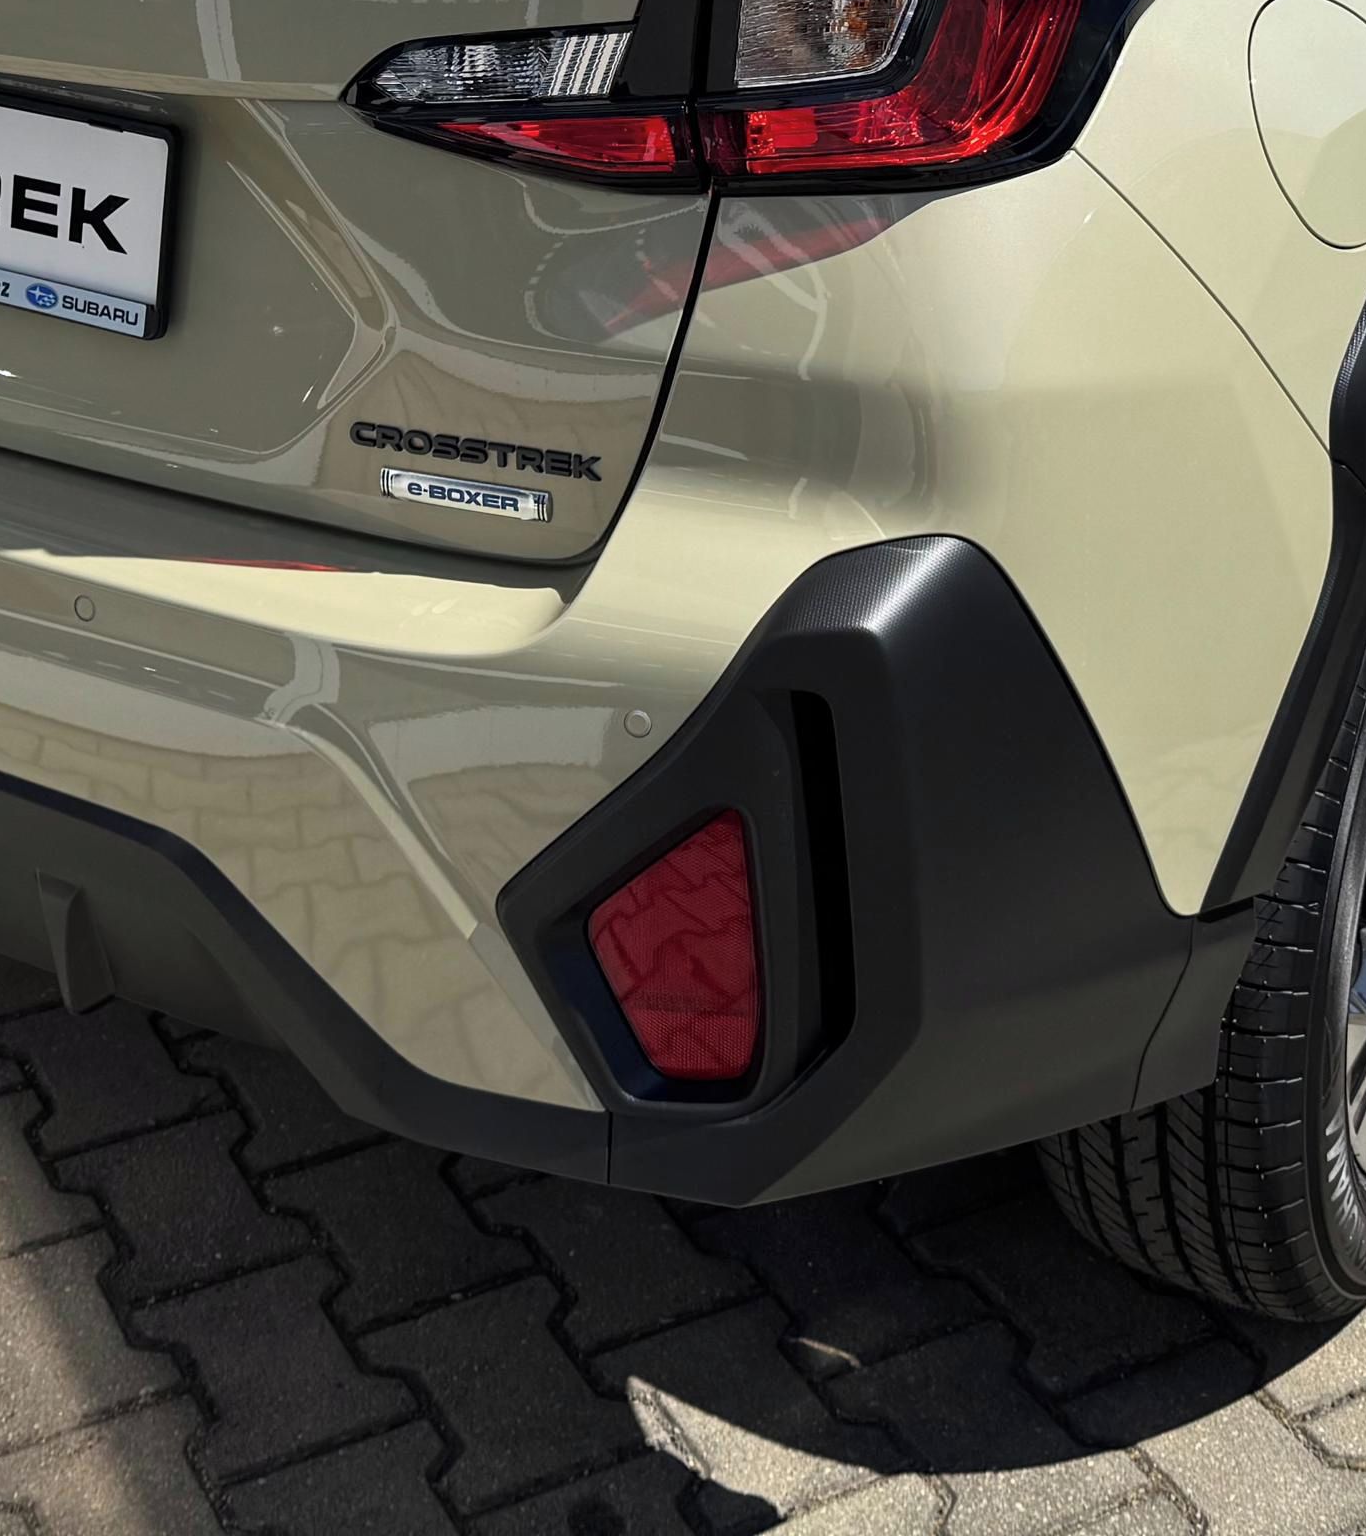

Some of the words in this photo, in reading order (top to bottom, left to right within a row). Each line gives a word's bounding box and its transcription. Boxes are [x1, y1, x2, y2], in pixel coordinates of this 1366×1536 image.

[62, 295, 139, 326] SUBARU
[349, 421, 603, 482] CROSSTREK
[407, 482, 520, 512] e-BOXER
